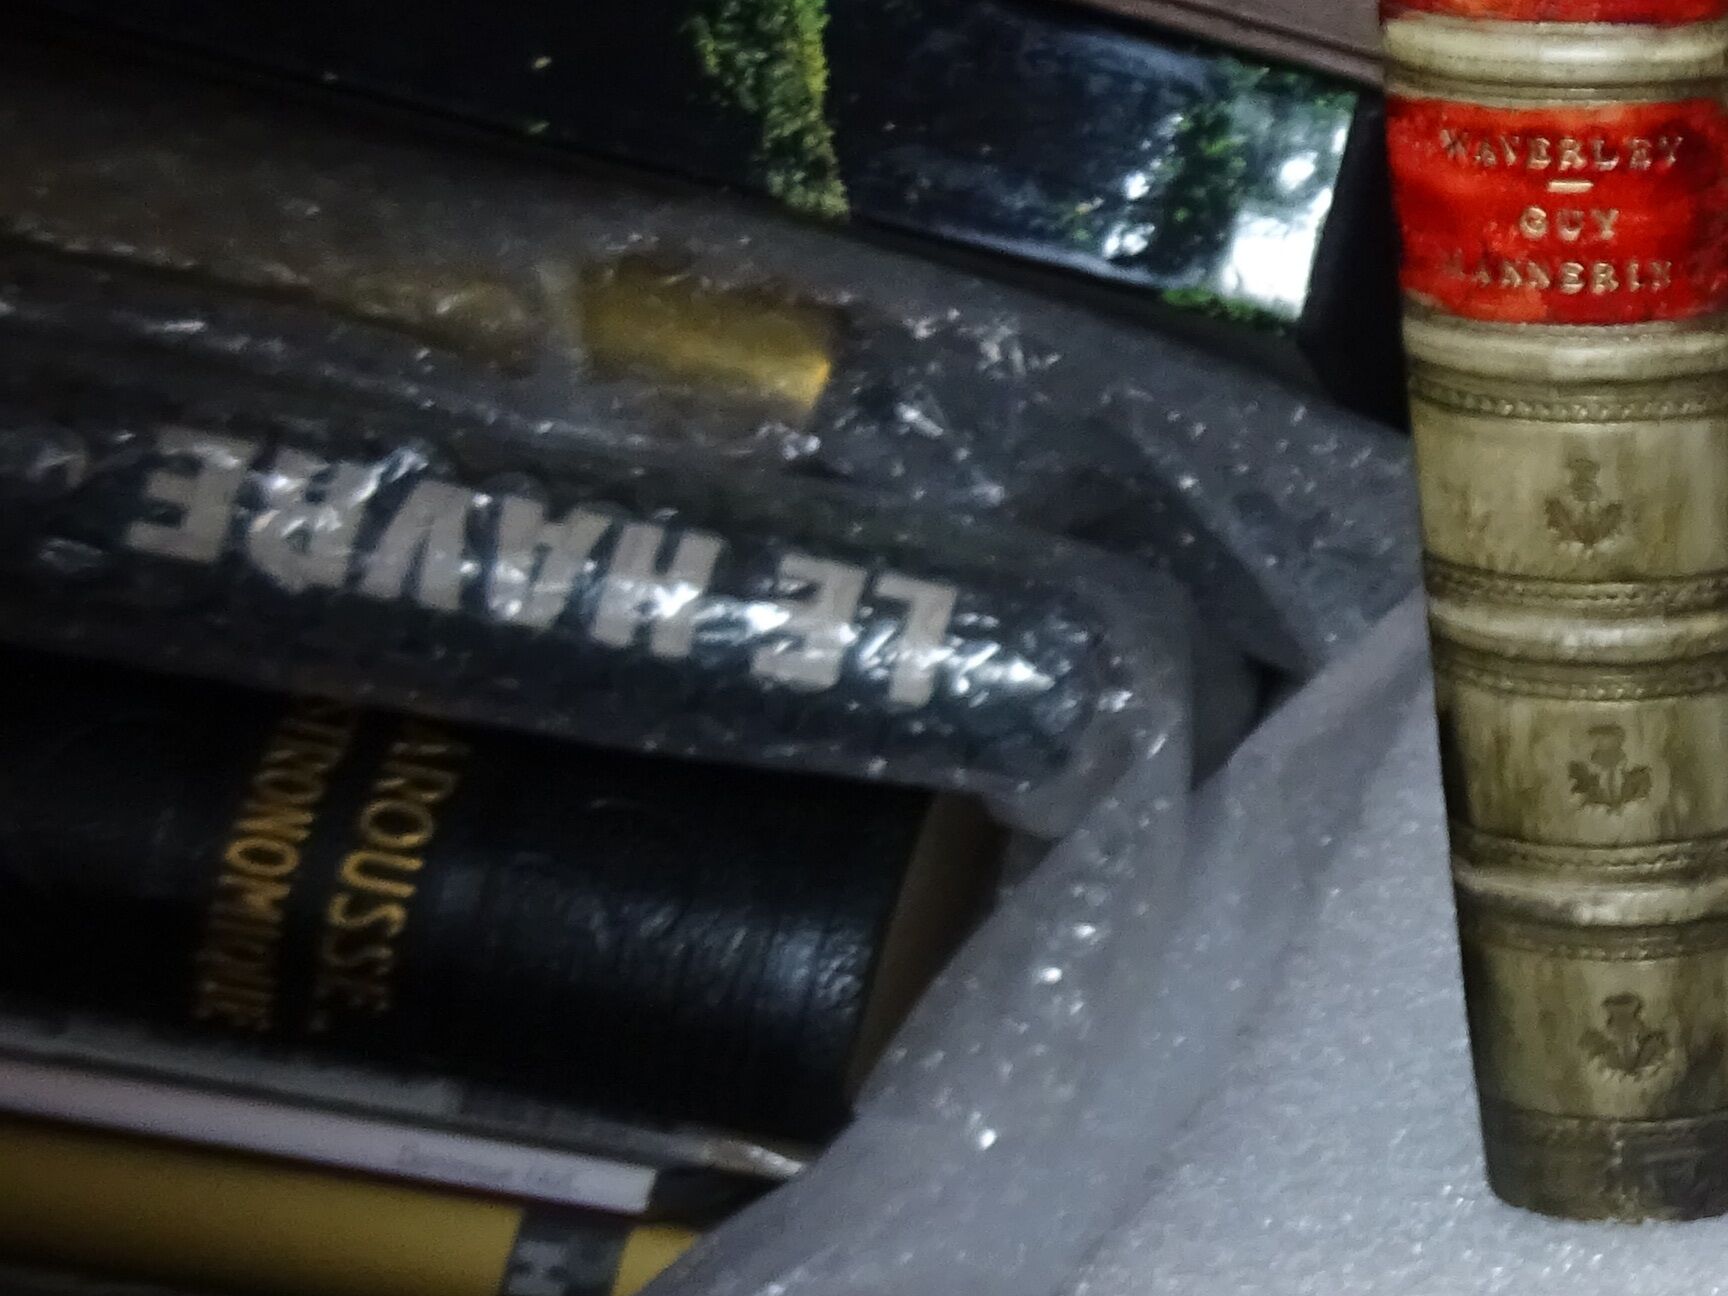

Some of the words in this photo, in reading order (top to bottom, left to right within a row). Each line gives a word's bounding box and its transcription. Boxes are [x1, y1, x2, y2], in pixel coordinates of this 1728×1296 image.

[1440, 129, 1683, 171] WAVERLEY
[1519, 205, 1620, 241] GUY
[124, 424, 728, 660] HAVRE
[749, 551, 959, 707] LE
